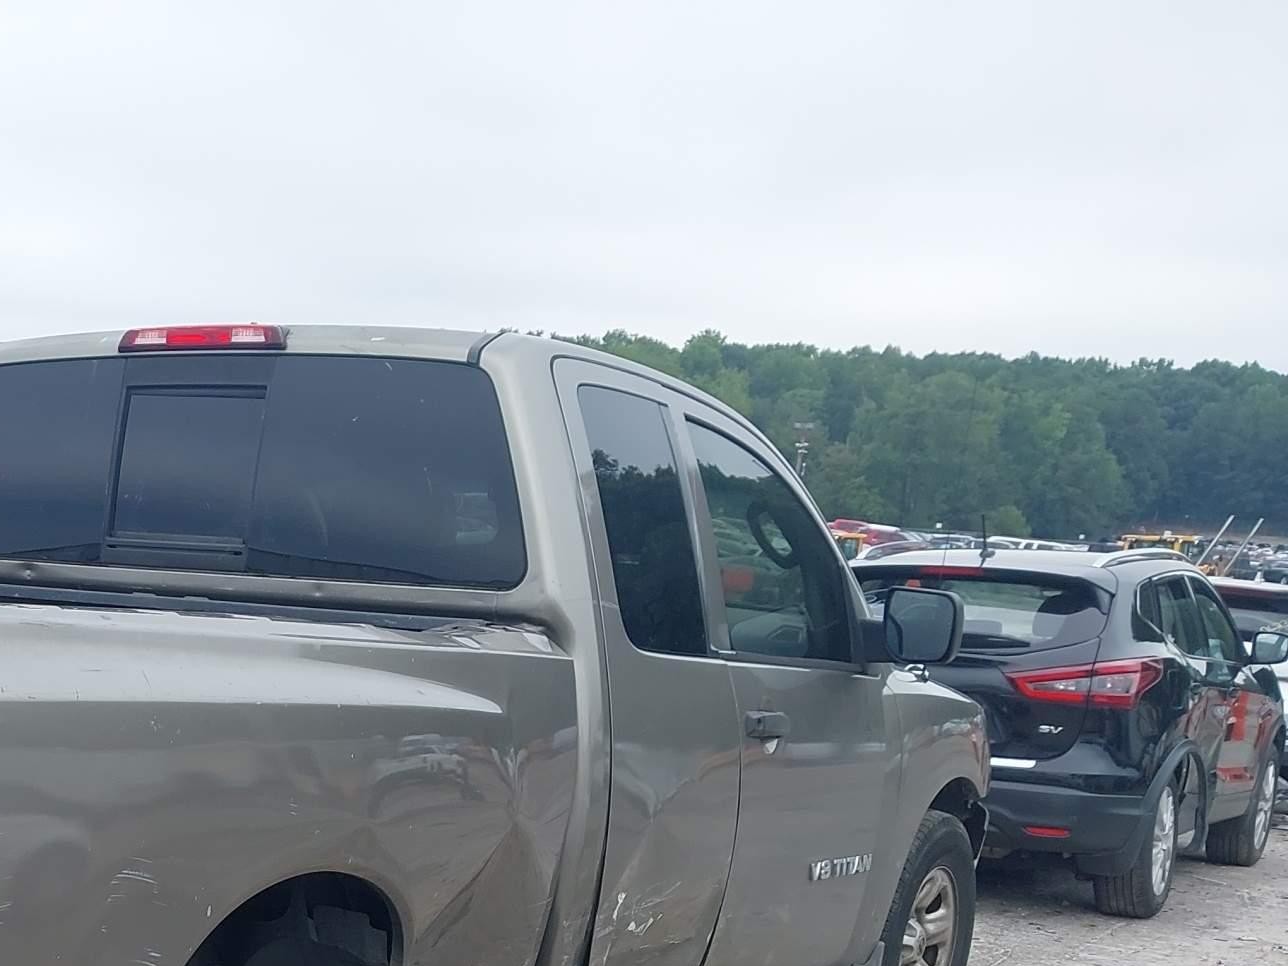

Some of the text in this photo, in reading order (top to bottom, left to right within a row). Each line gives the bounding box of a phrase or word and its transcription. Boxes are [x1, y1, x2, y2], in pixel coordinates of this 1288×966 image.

[1039, 725, 1064, 734] SV
[810, 853, 873, 881] V8 TITAN
